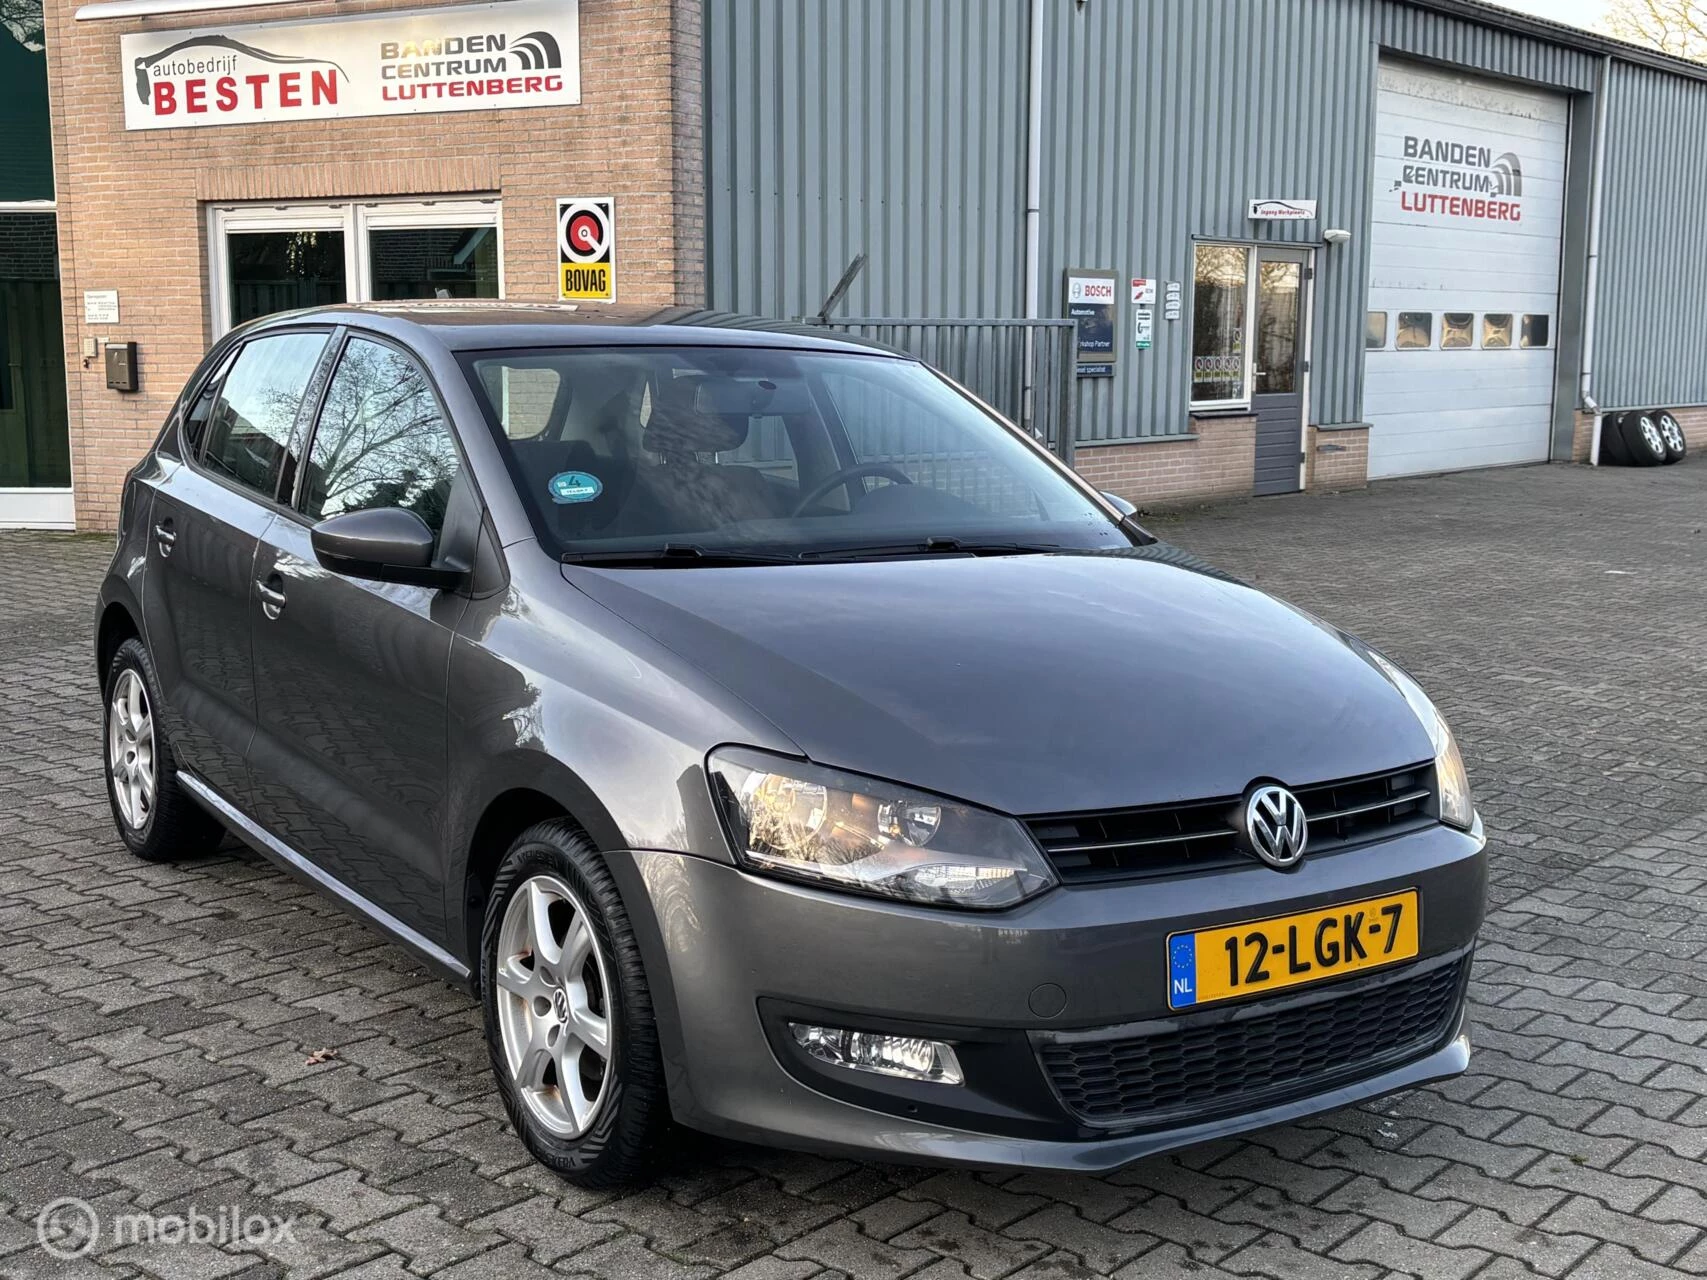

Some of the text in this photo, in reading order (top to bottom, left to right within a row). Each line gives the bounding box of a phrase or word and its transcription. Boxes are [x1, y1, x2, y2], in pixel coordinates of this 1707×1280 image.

[381, 33, 506, 60] BANDEN
[153, 55, 238, 77] autobedrijf
[381, 57, 507, 80] CENTRUM
[153, 69, 338, 115] BESTEN
[382, 75, 563, 101] LUTTENBERG
[1403, 135, 1491, 168] BANDEN
[1402, 165, 1489, 193] CENTRUM
[1401, 191, 1521, 221] LUTTENBERG
[565, 269, 606, 292] BOVAG
[1084, 285, 1112, 297] BOSCH
[1071, 308, 1095, 316] Automotive
[568, 475, 581, 487] 4
[1174, 903, 1403, 995] NL 12-LGK-7
